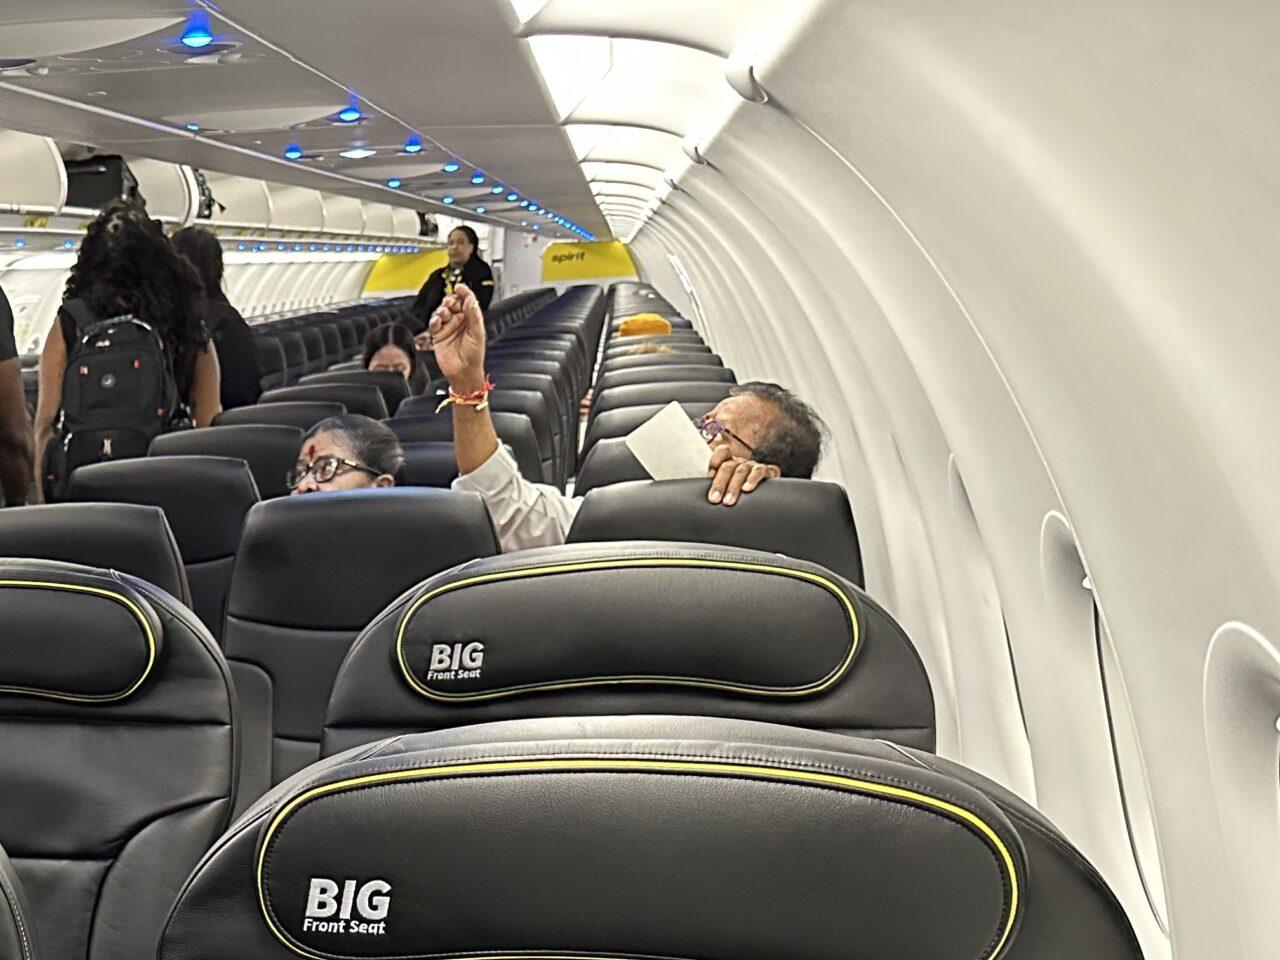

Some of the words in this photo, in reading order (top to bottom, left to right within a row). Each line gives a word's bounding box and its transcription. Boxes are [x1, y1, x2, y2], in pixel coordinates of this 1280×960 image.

[430, 641, 485, 671] BIG
[427, 669, 456, 680] Front
[457, 668, 481, 679] Seat
[305, 877, 392, 920] BIG
[303, 918, 346, 934] Front
[349, 919, 386, 936] Seat
